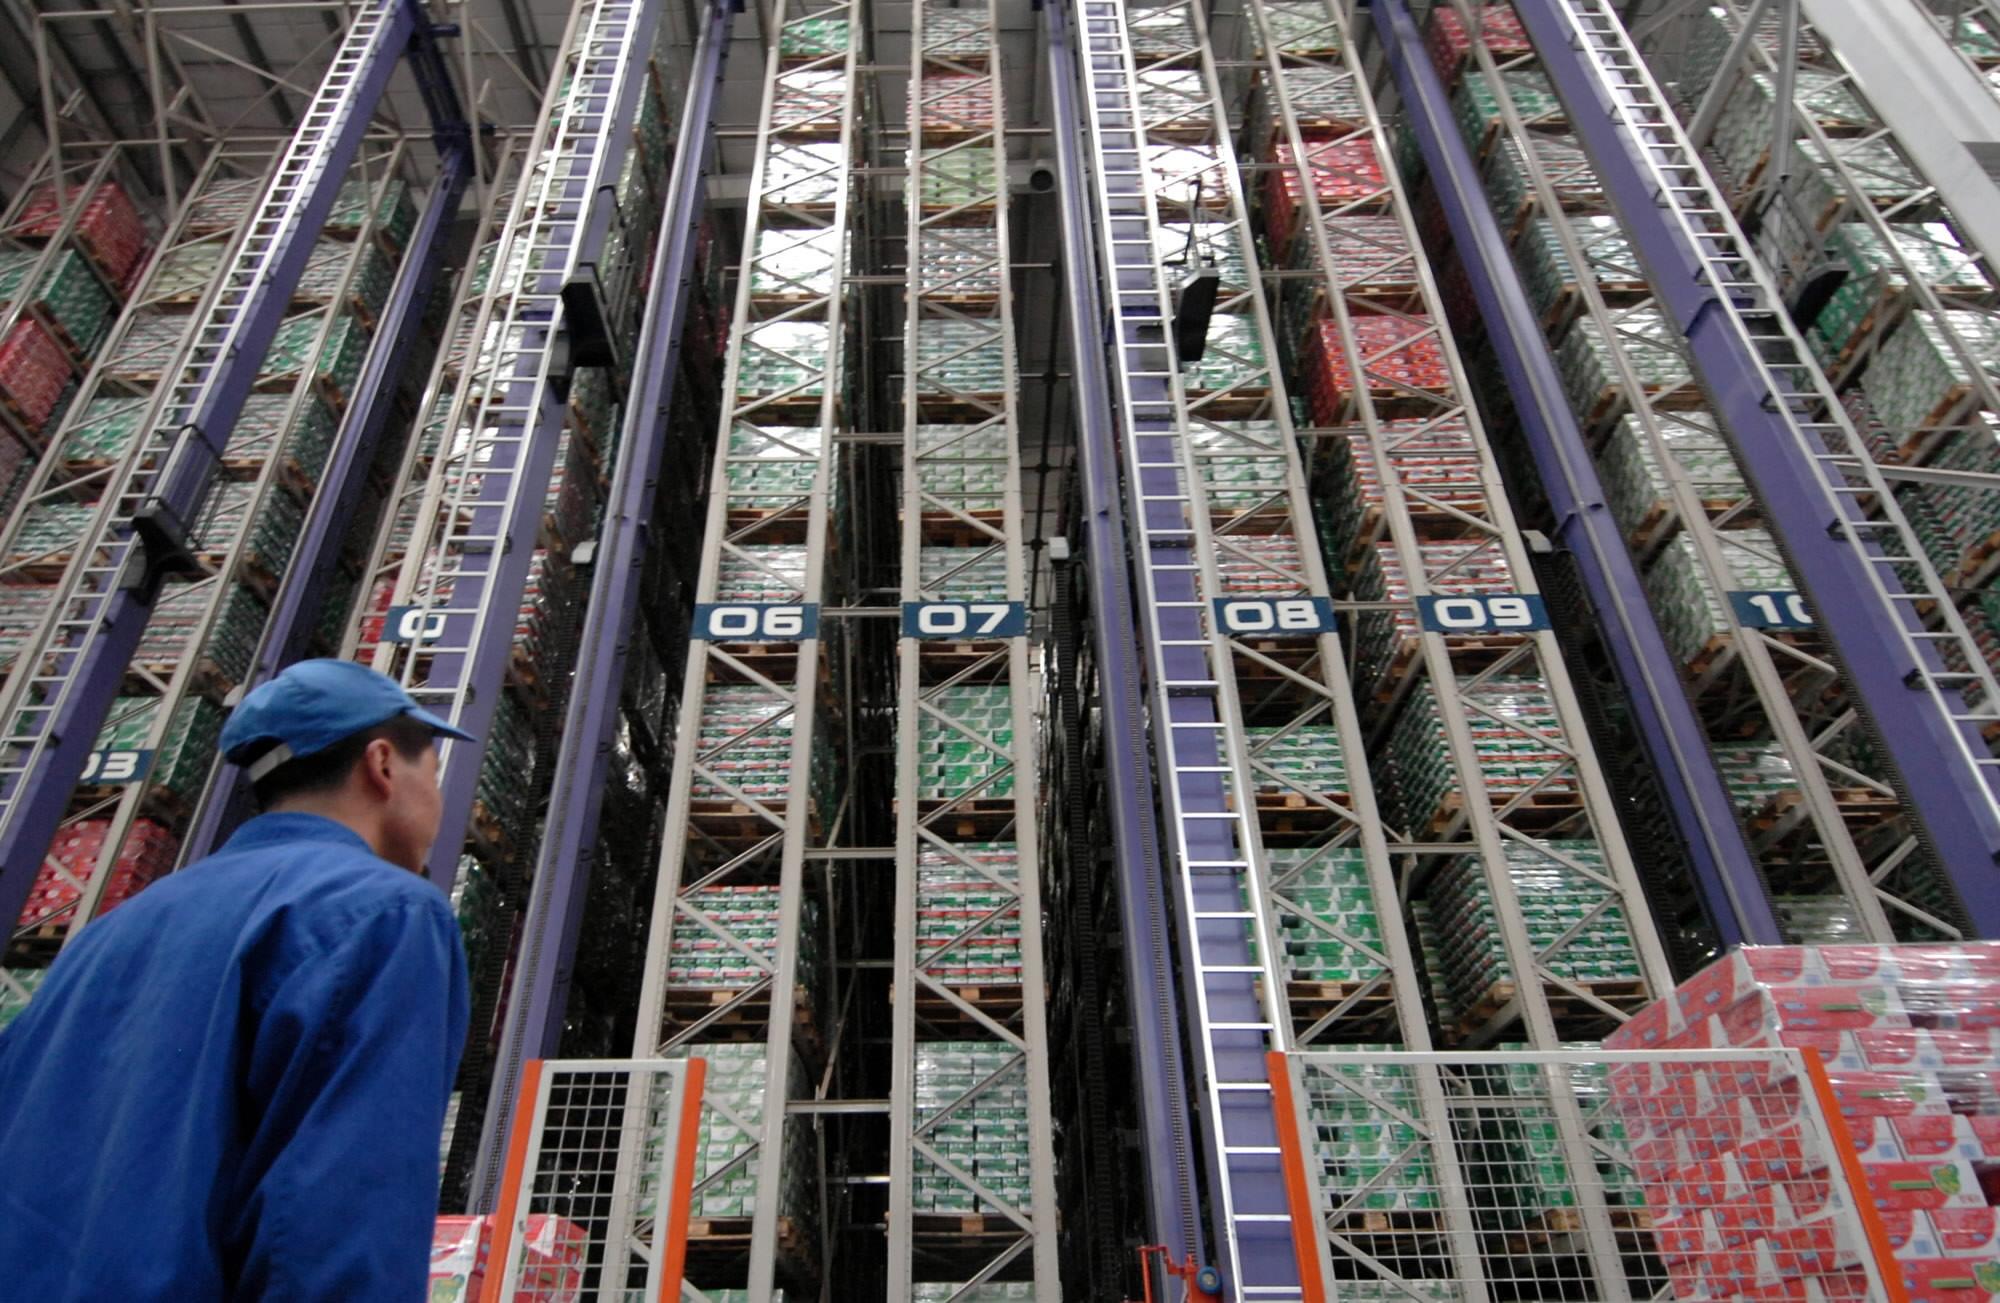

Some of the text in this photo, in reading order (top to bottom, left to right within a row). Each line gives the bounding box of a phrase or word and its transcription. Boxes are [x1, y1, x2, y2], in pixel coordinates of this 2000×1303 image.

[398, 608, 448, 639] 0
[708, 606, 803, 636] 06
[918, 604, 1010, 634] 07
[1223, 600, 1321, 631] 08
[1434, 597, 1533, 628] 09
